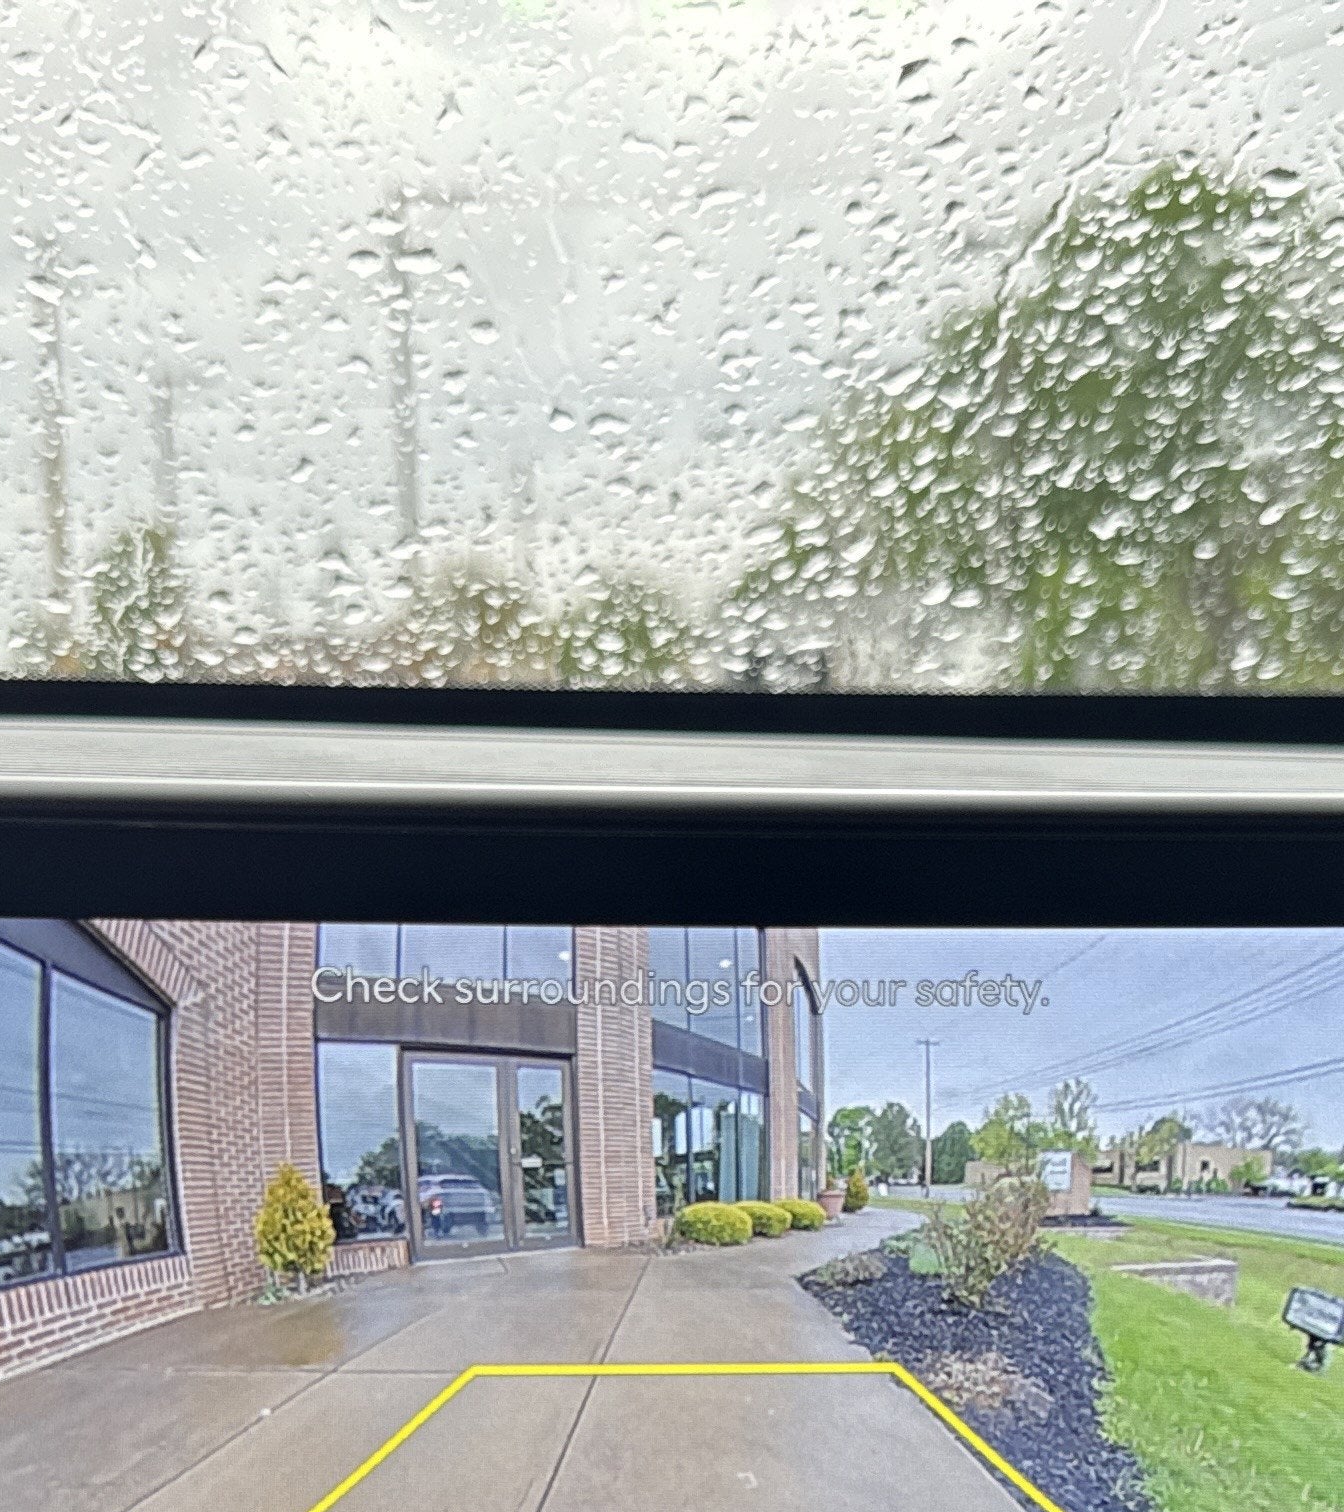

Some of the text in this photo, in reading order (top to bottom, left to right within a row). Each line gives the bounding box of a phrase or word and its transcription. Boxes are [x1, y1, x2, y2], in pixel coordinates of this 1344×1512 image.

[311, 966, 1050, 1016] Check surroundings for your safety.
